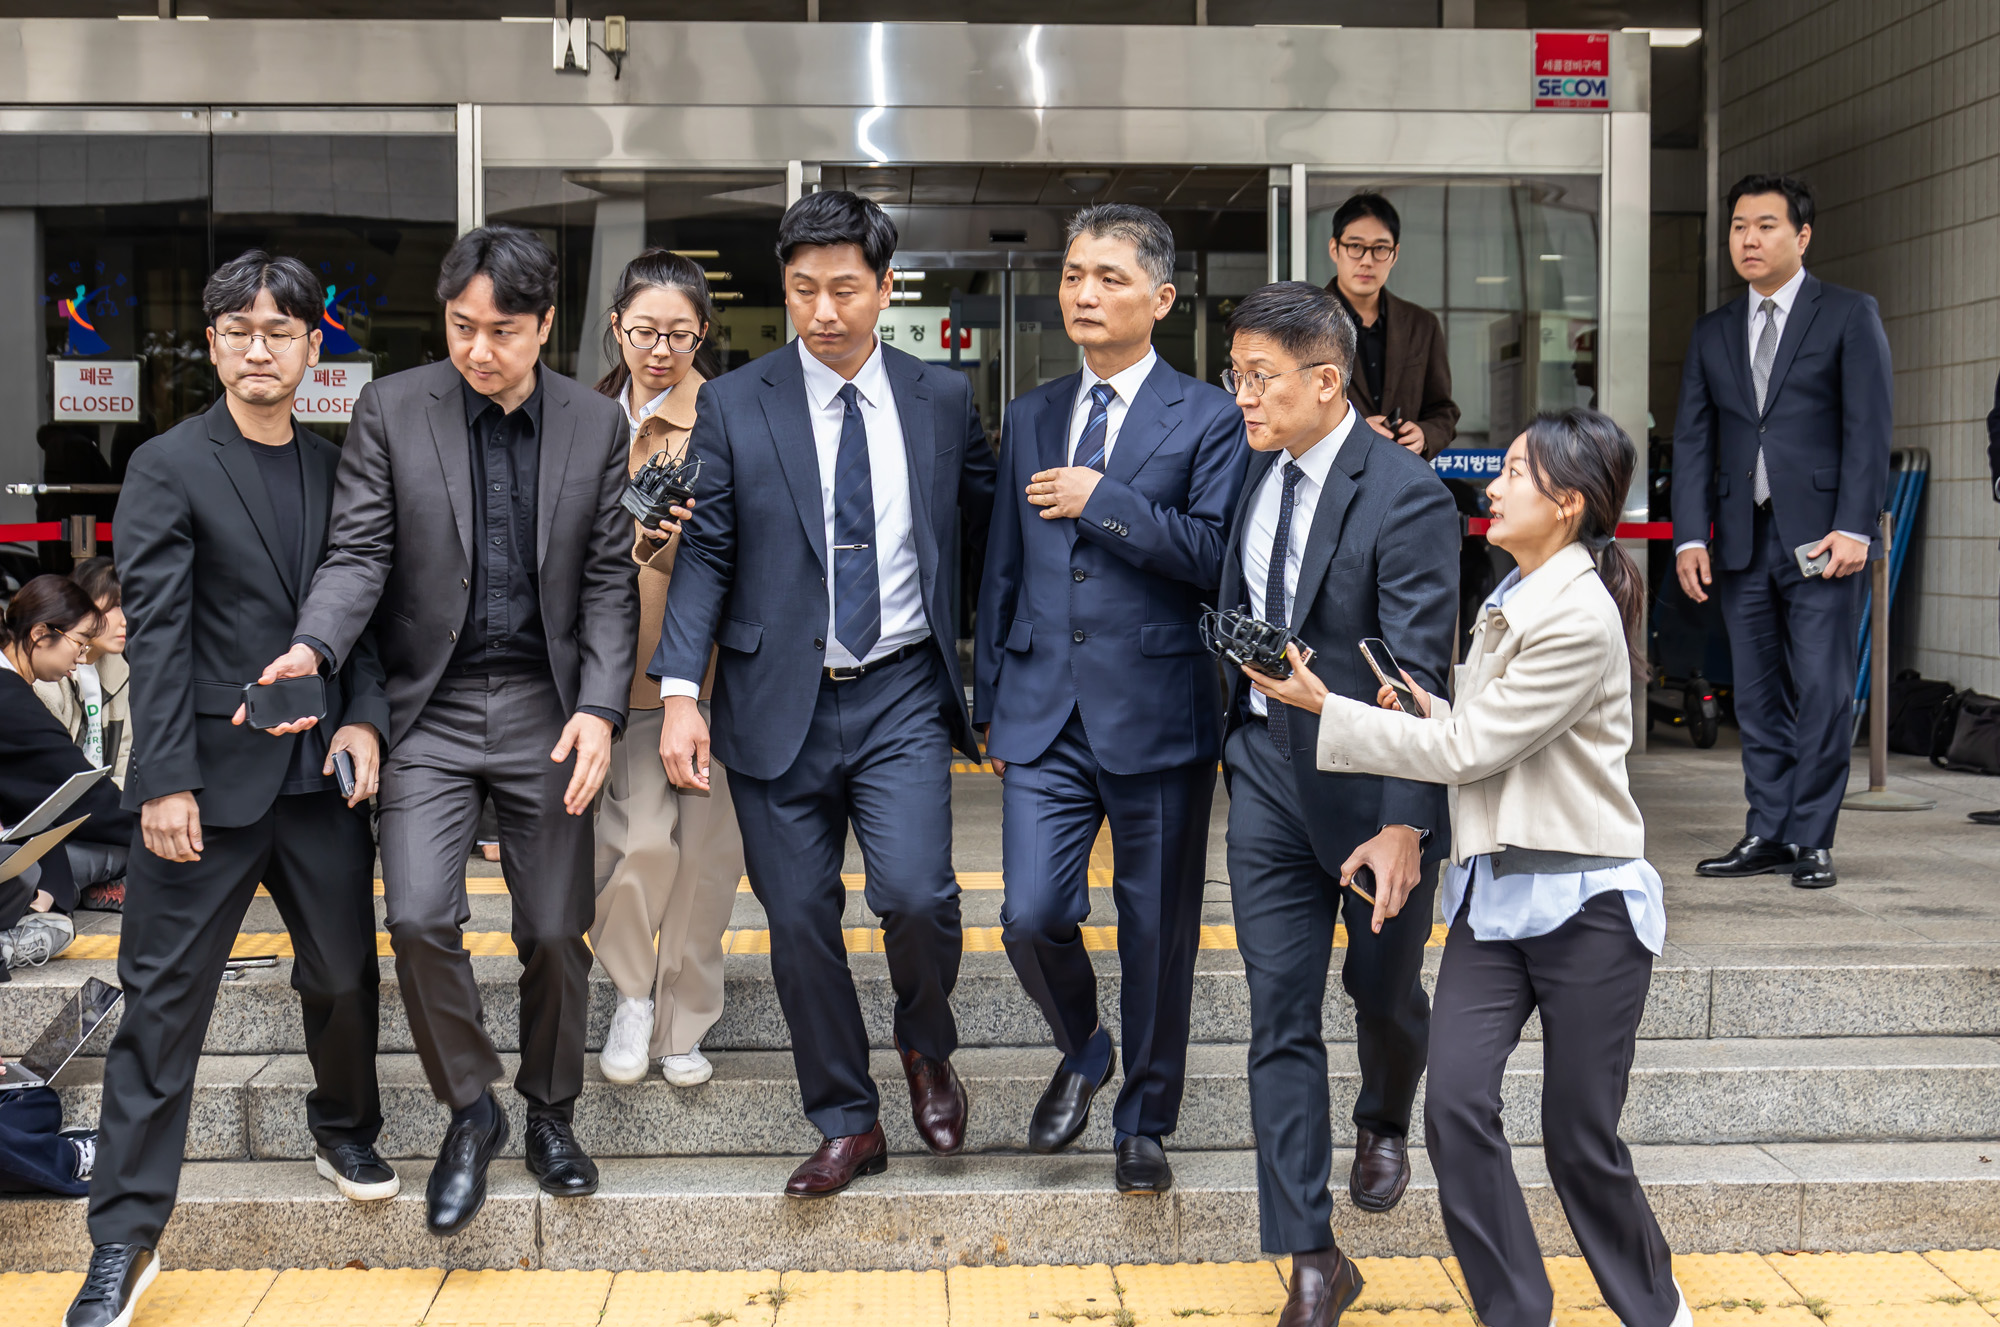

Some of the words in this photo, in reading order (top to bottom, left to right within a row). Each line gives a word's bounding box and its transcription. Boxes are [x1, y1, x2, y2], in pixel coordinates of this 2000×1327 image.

[1538, 79, 1607, 97] SECOM
[79, 367, 114, 386] 폐문
[313, 369, 348, 387] 폐문
[59, 395, 135, 412] CLOSED
[293, 397, 359, 413] CLOSE
[1428, 455, 1506, 473] 부지방법
